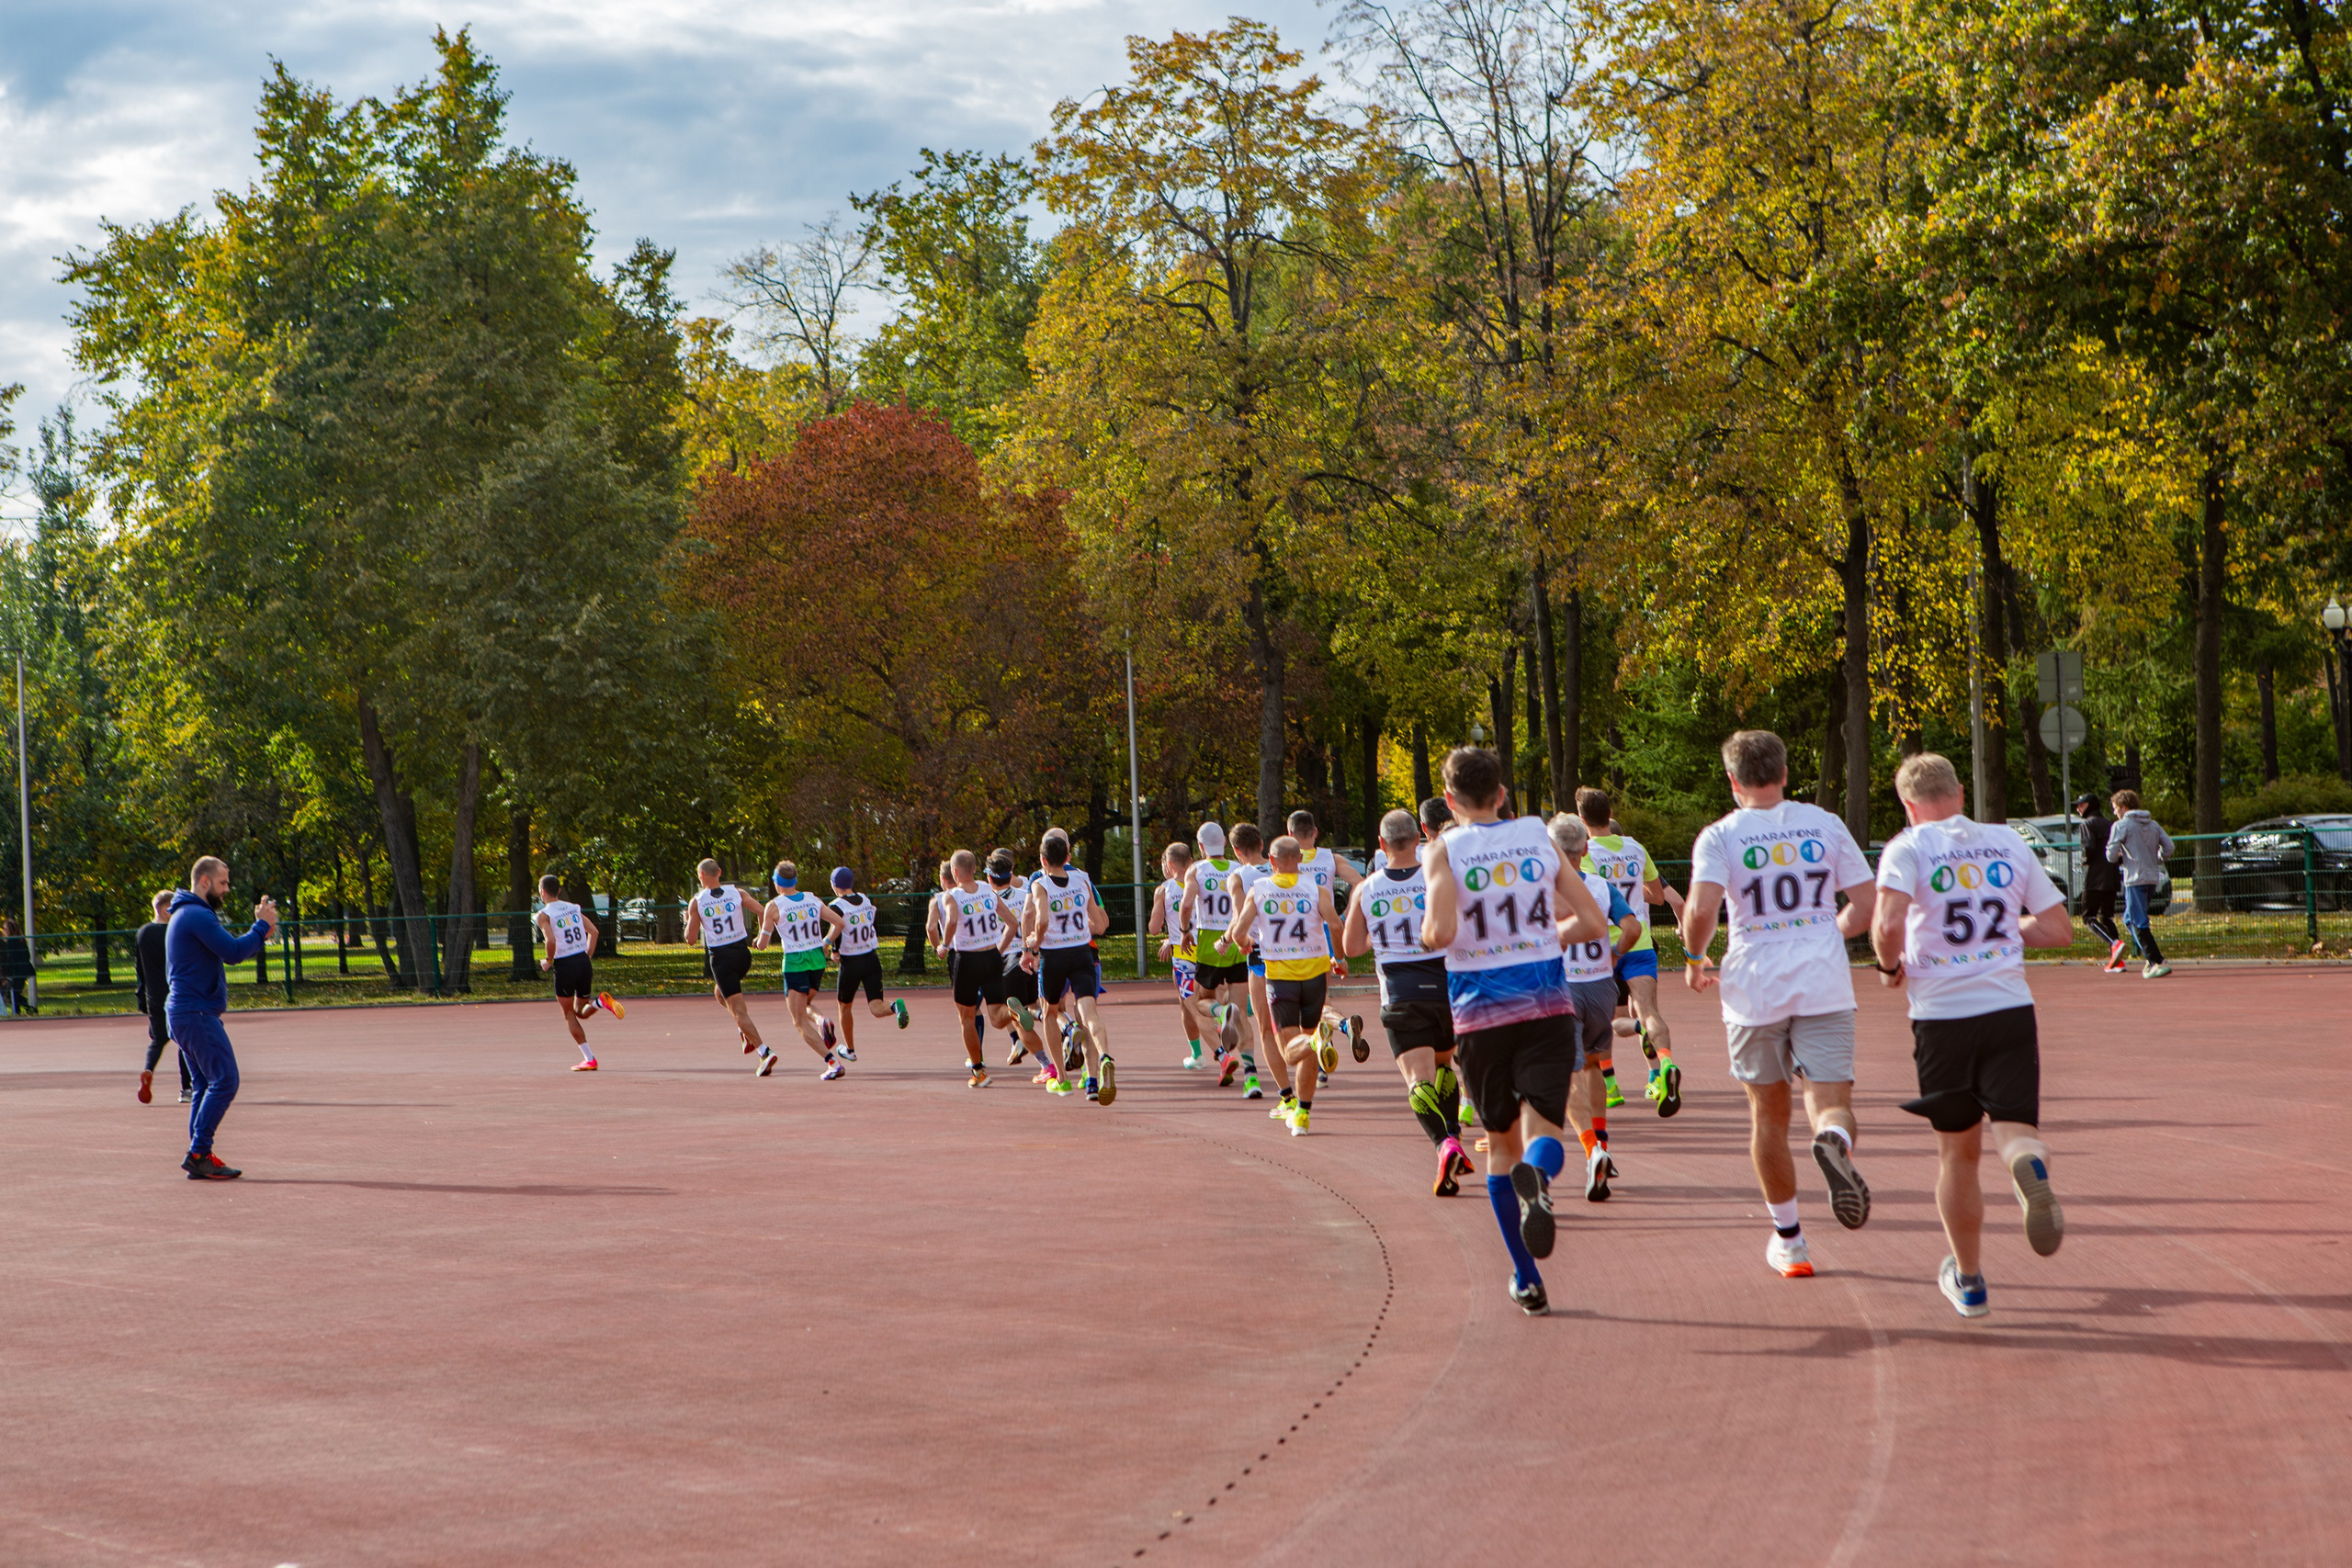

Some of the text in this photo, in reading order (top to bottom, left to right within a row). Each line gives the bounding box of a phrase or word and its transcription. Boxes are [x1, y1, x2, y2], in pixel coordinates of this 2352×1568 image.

[1739, 829, 1823, 846] VMARAFONE
[1461, 846, 1541, 866] VMARAFONE
[1928, 848, 2012, 866] VMARAFONE
[1370, 885, 1426, 900] VMARAFON
[1614, 881, 1636, 905] 7
[1741, 869, 1831, 917] 107
[1204, 894, 1230, 915] 10
[1463, 887, 1551, 942] 114
[712, 915, 734, 934] 51
[788, 920, 820, 942] 110
[963, 912, 999, 937] 118
[1056, 910, 1084, 934] 70
[1269, 918, 1308, 943] 74
[1373, 915, 1425, 949] 11
[1942, 897, 2010, 947] 52
[564, 926, 582, 944] 58
[1569, 940, 1603, 962] 16
